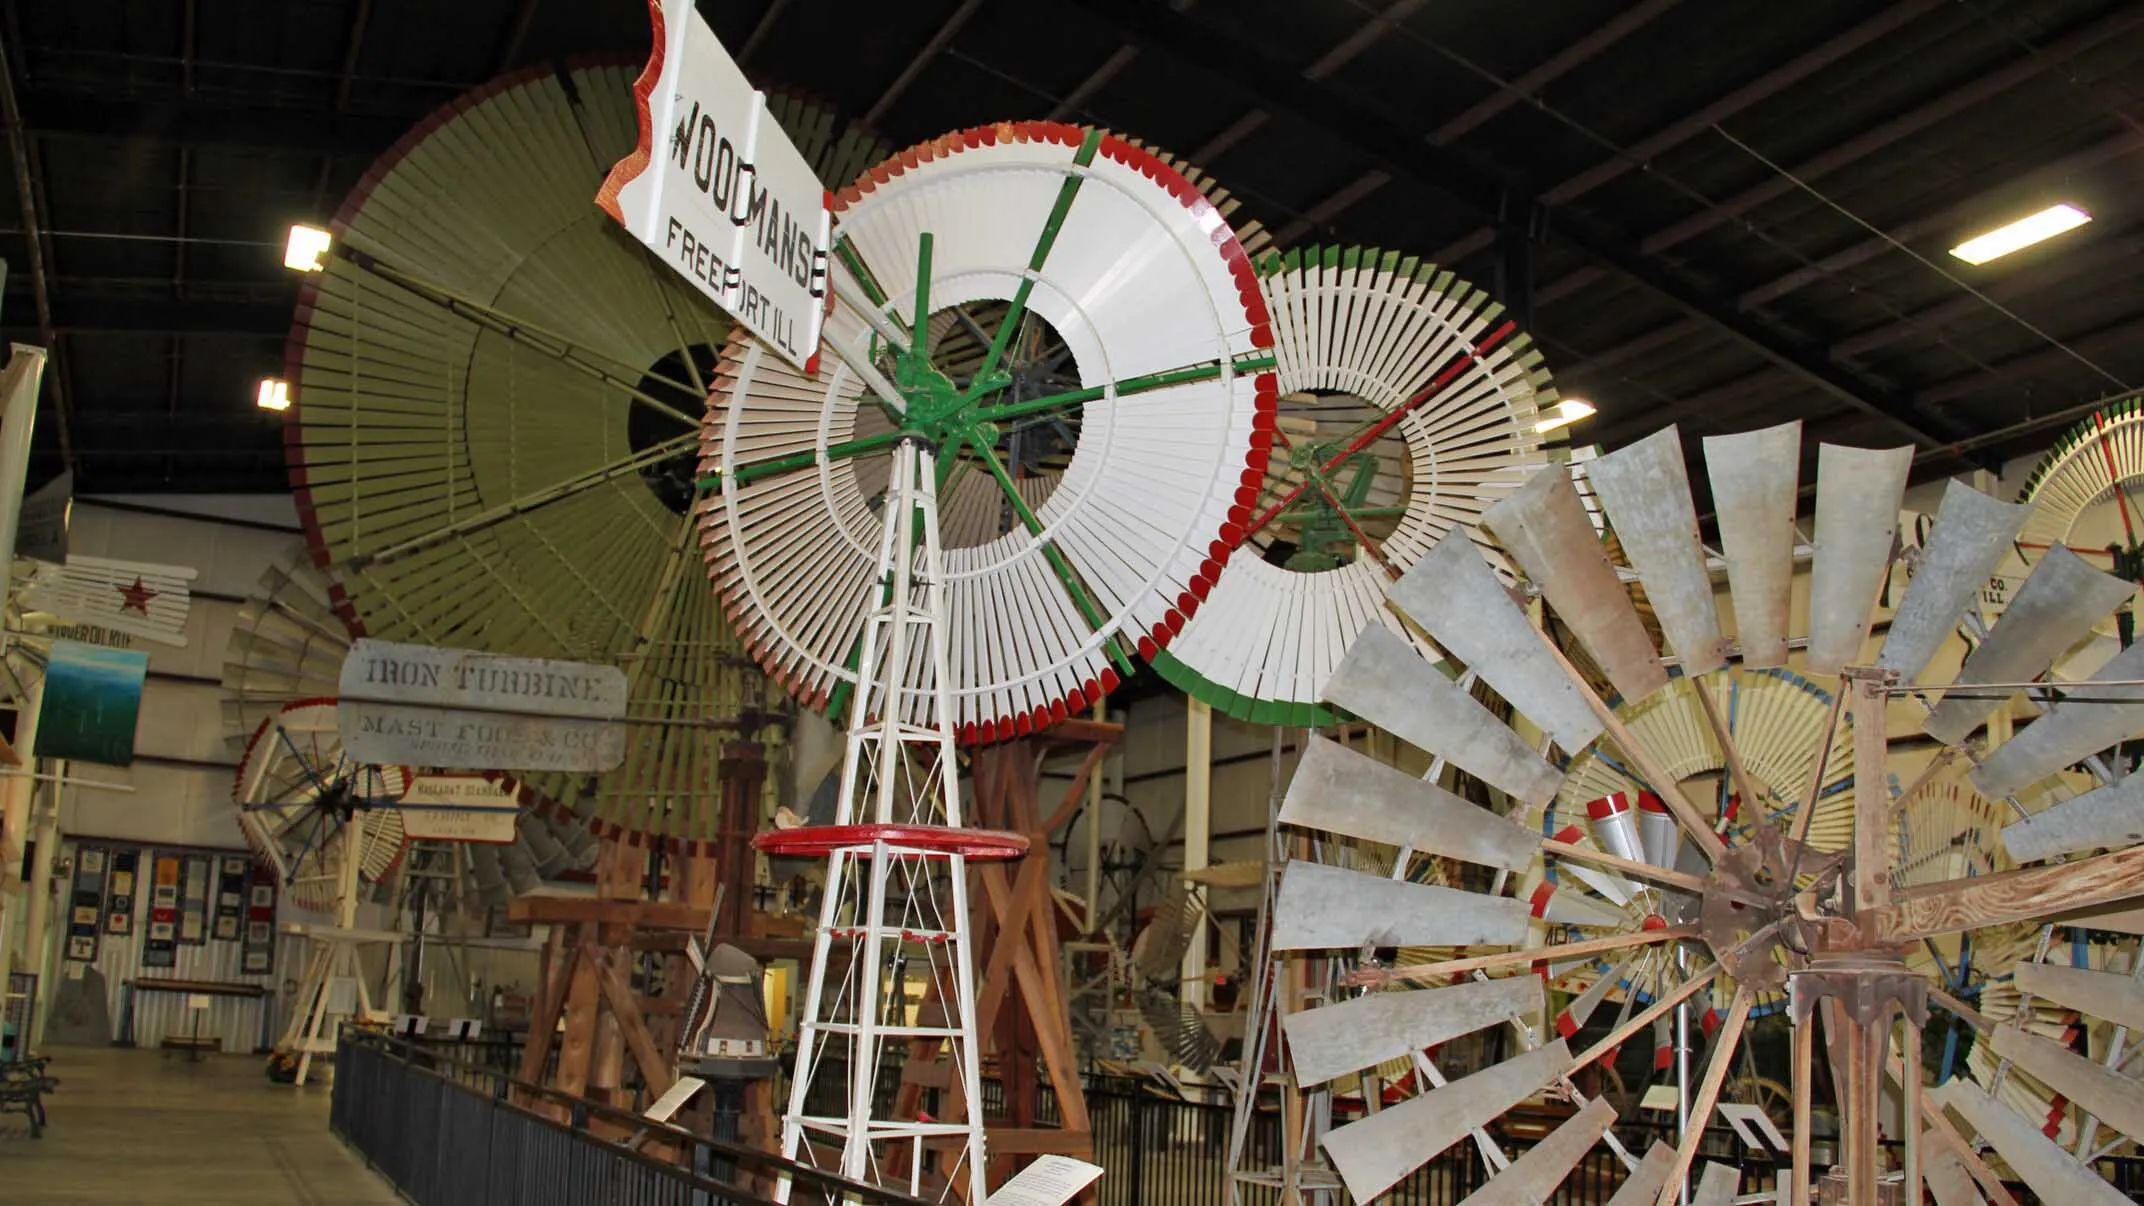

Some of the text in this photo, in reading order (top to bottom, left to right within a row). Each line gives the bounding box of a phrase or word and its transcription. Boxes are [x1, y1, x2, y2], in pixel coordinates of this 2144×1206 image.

[671, 100, 827, 298] WOODMANSE
[773, 307, 797, 357] ILL
[366, 658, 442, 687] IRON
[361, 715, 443, 738] MAST
